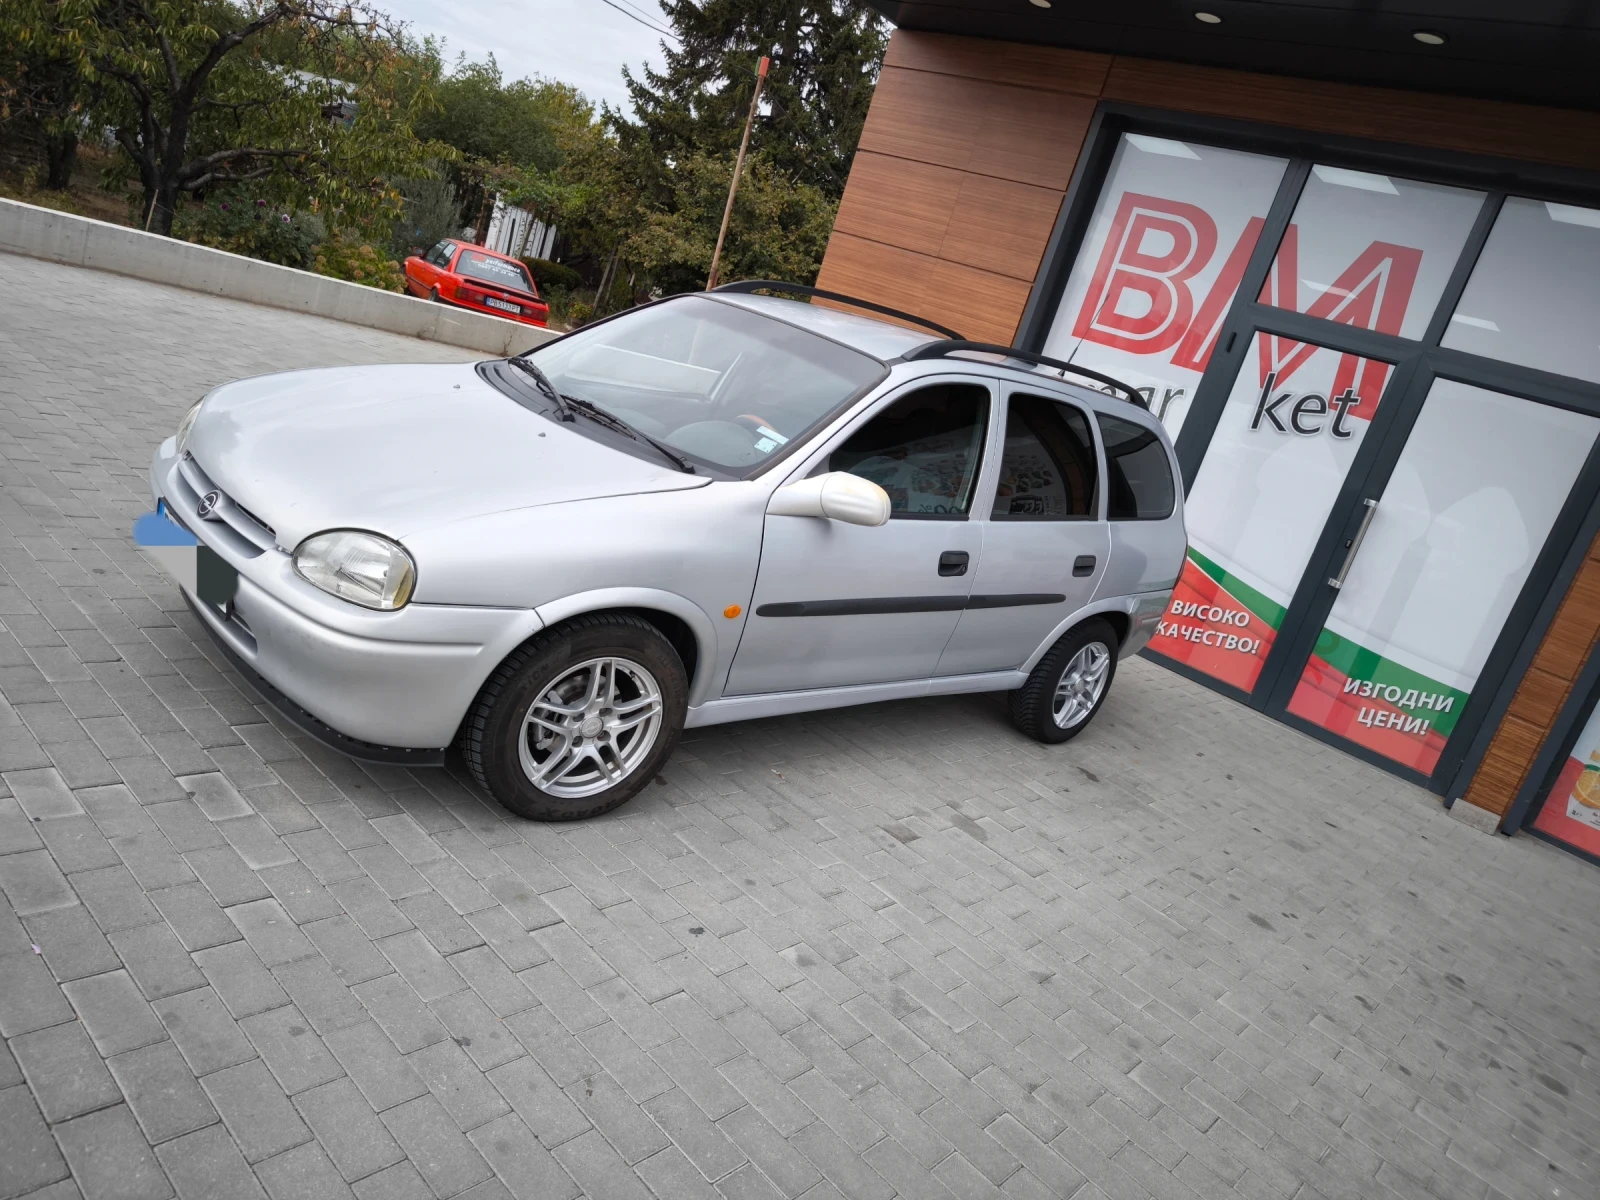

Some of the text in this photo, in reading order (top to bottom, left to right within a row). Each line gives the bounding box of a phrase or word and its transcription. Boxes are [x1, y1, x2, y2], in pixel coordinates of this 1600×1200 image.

[1072, 191, 1424, 421] BM
[1249, 371, 1361, 439] ket
[1170, 599, 1250, 627] ВИСОКО
[1155, 620, 1261, 655] КАЧЕСТВО!
[1343, 677, 1455, 713] ИЗГОДНИ
[1357, 706, 1431, 736] ЦЕНИ!
